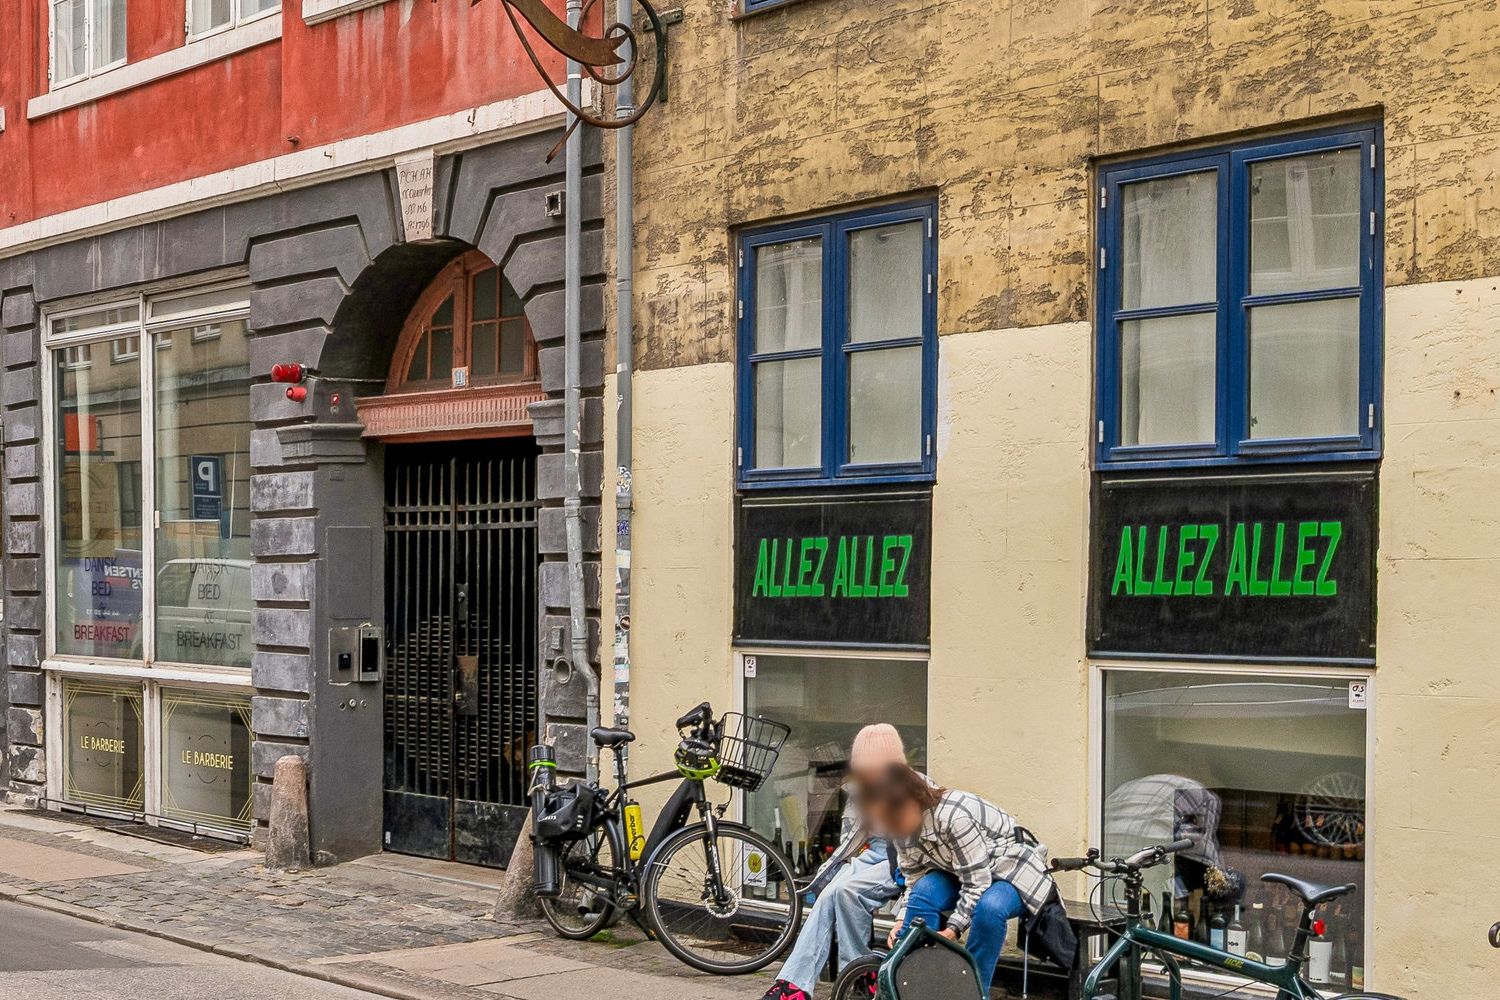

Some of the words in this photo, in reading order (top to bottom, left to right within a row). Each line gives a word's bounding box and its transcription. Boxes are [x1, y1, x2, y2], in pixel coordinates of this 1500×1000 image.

[752, 536, 828, 597] ALLEZ
[831, 534, 912, 597] ALLEZ
[1111, 524, 1219, 595] ALLEZ
[1224, 521, 1342, 596] ALLEZ
[91, 581, 112, 597] BED
[197, 584, 221, 600] BED
[74, 624, 131, 643] BREAKFAST
[176, 630, 243, 651] BREAKFAST
[80, 735, 90, 750] LE
[91, 737, 125, 754] BARBERIE
[181, 750, 192, 764] LE
[193, 751, 234, 770] BARBERIE
